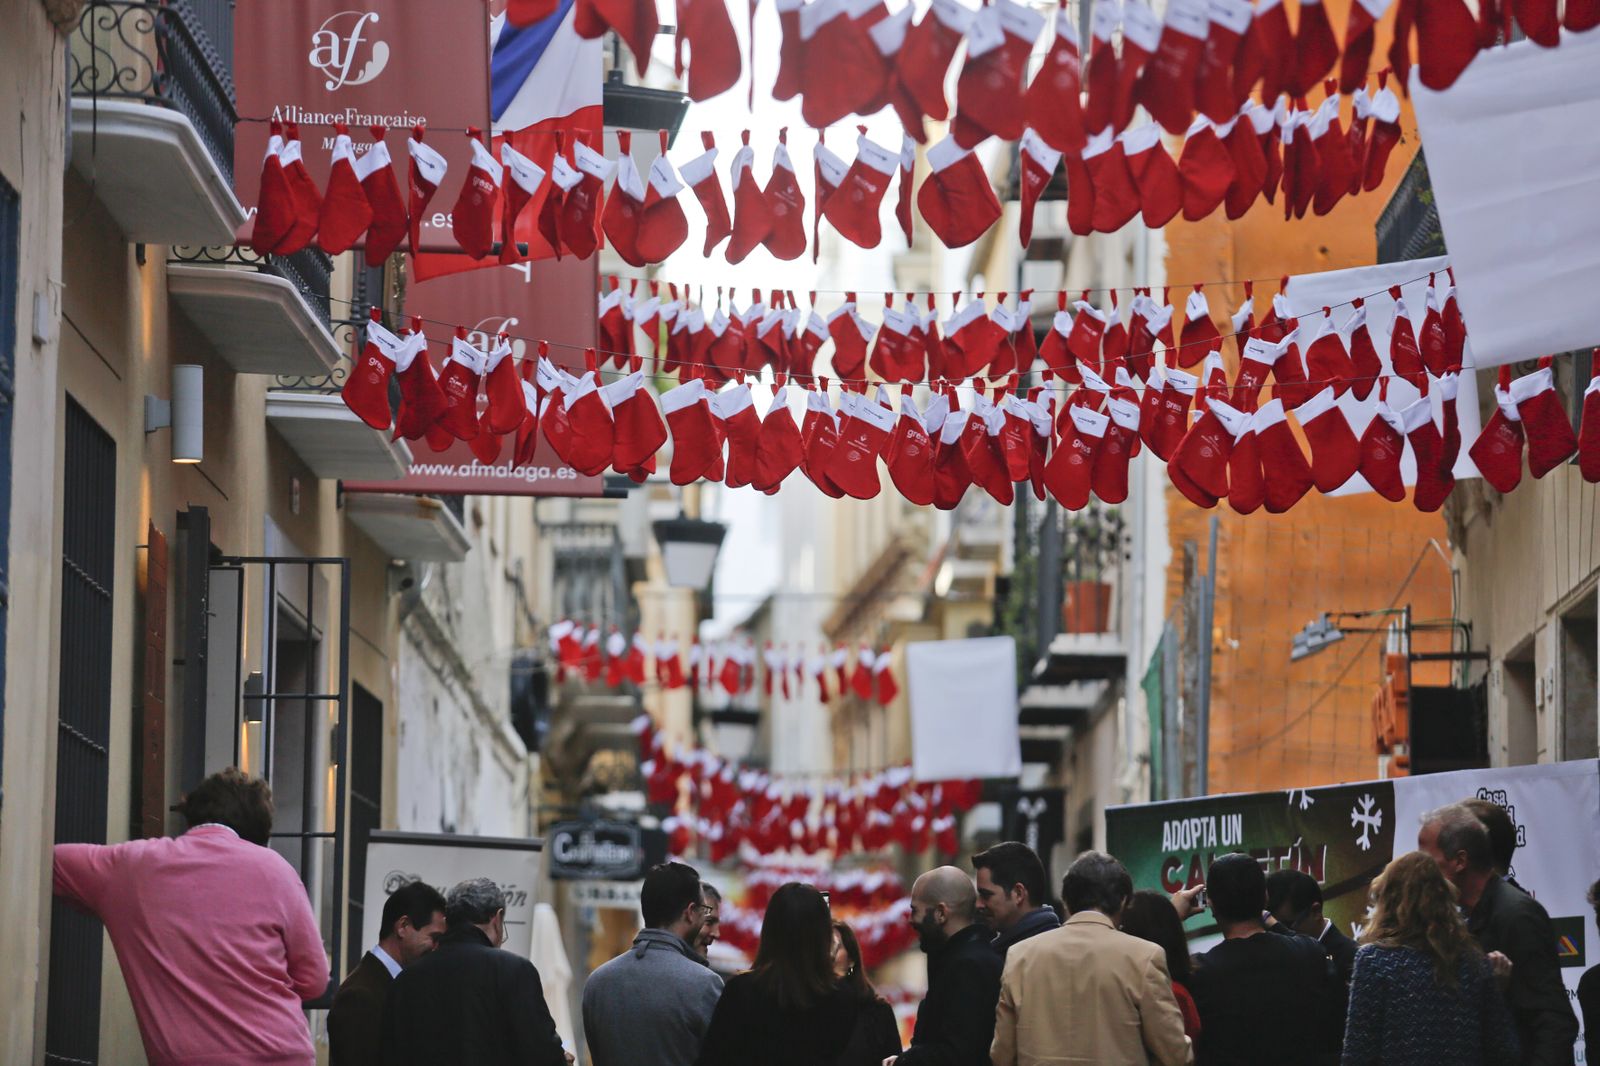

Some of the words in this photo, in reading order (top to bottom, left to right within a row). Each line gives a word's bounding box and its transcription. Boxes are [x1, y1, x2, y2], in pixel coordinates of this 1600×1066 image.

[321, 136, 373, 154] Mga
[408, 459, 578, 483] www.afmalaga.es
[1161, 815, 1217, 853] ADOPTA
[1220, 813, 1243, 846] UN
[1160, 836, 1328, 895] CAETÍN
